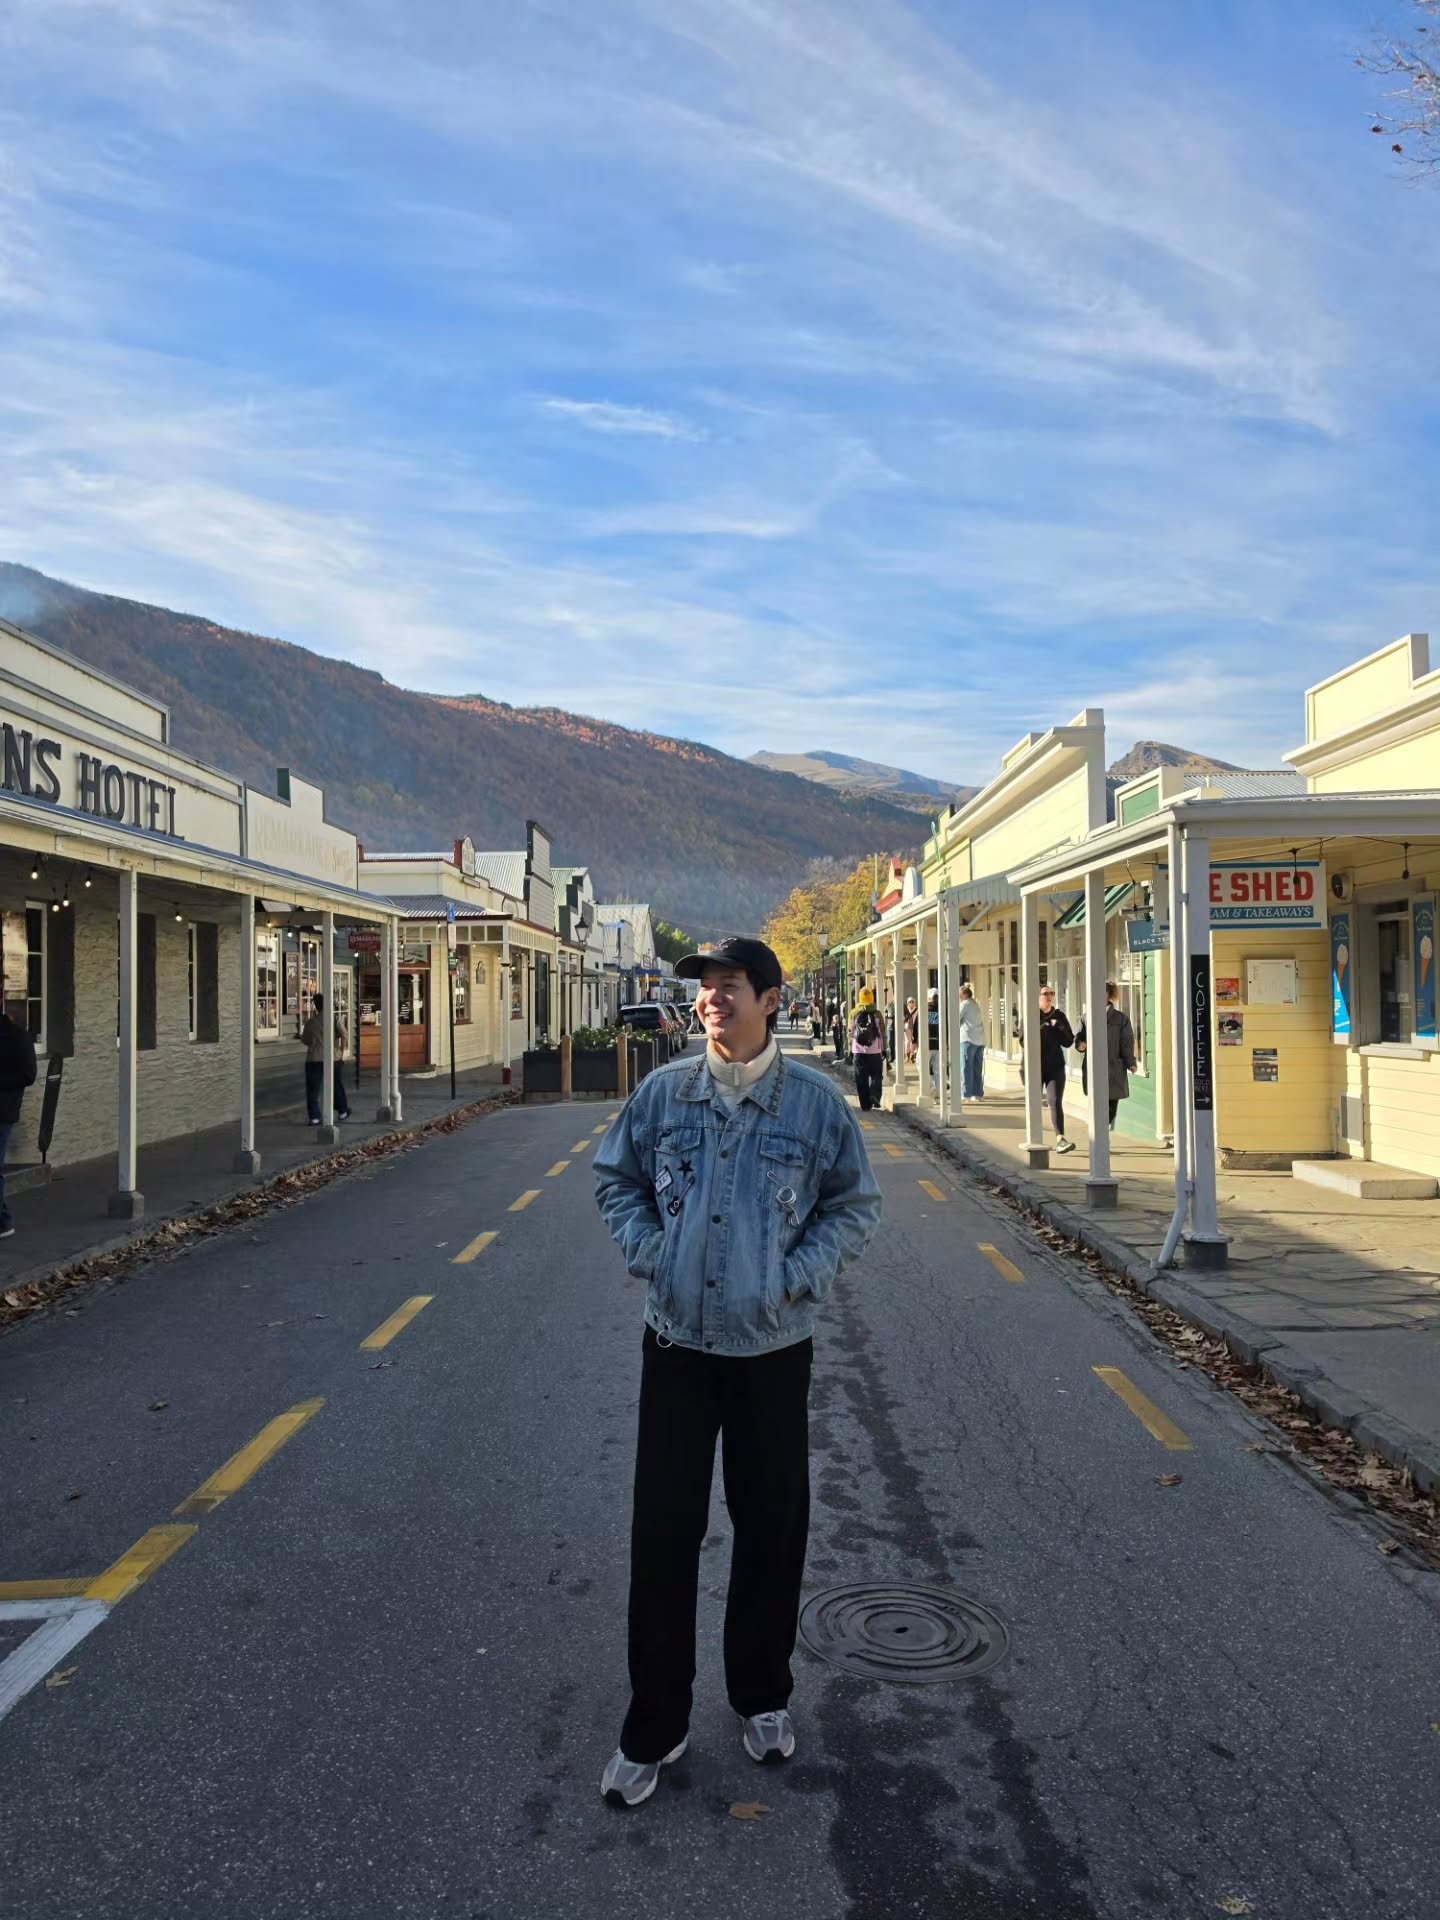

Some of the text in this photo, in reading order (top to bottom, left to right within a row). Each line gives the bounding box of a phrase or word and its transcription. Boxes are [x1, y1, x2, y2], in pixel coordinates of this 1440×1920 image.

[79, 752, 185, 840] HOTEL
[1230, 871, 1314, 902] SHED
[1232, 909, 1241, 918] &
[1246, 907, 1311, 918] TAKEAWAYS
[1196, 971, 1206, 1076] COFFEE
